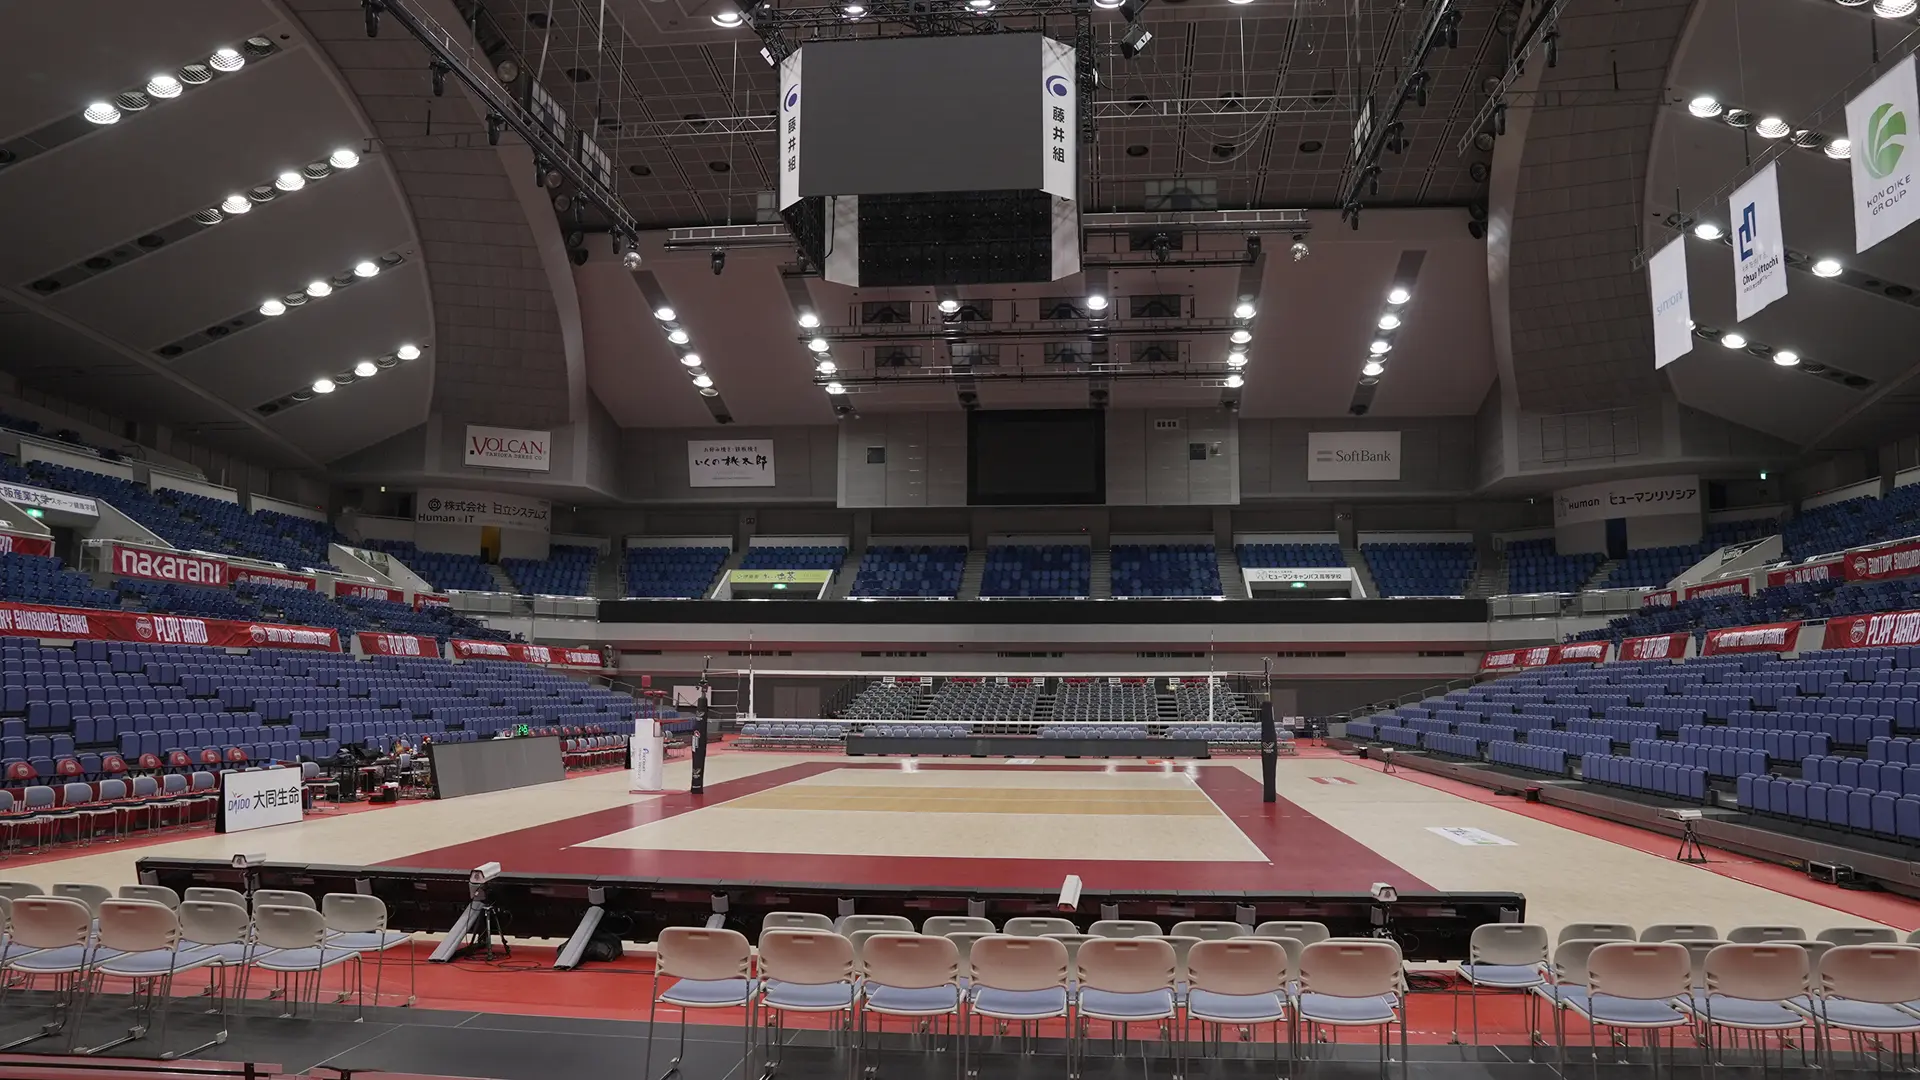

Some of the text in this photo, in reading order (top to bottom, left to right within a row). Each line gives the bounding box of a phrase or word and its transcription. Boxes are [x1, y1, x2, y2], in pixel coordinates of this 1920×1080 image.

[787, 116, 797, 173] 藤井組
[1052, 105, 1065, 164] 藤井組
[1866, 174, 1911, 208] KONOIKE
[1872, 189, 1907, 216] GROUP
[472, 436, 544, 456] VOLCAN
[1335, 450, 1391, 463] SoftBank
[418, 513, 455, 523] Human
[444, 500, 487, 514] 株式会社
[153, 616, 183, 643] PLAY
[1866, 614, 1897, 645] PLAY
[253, 786, 300, 810] 大同生命
